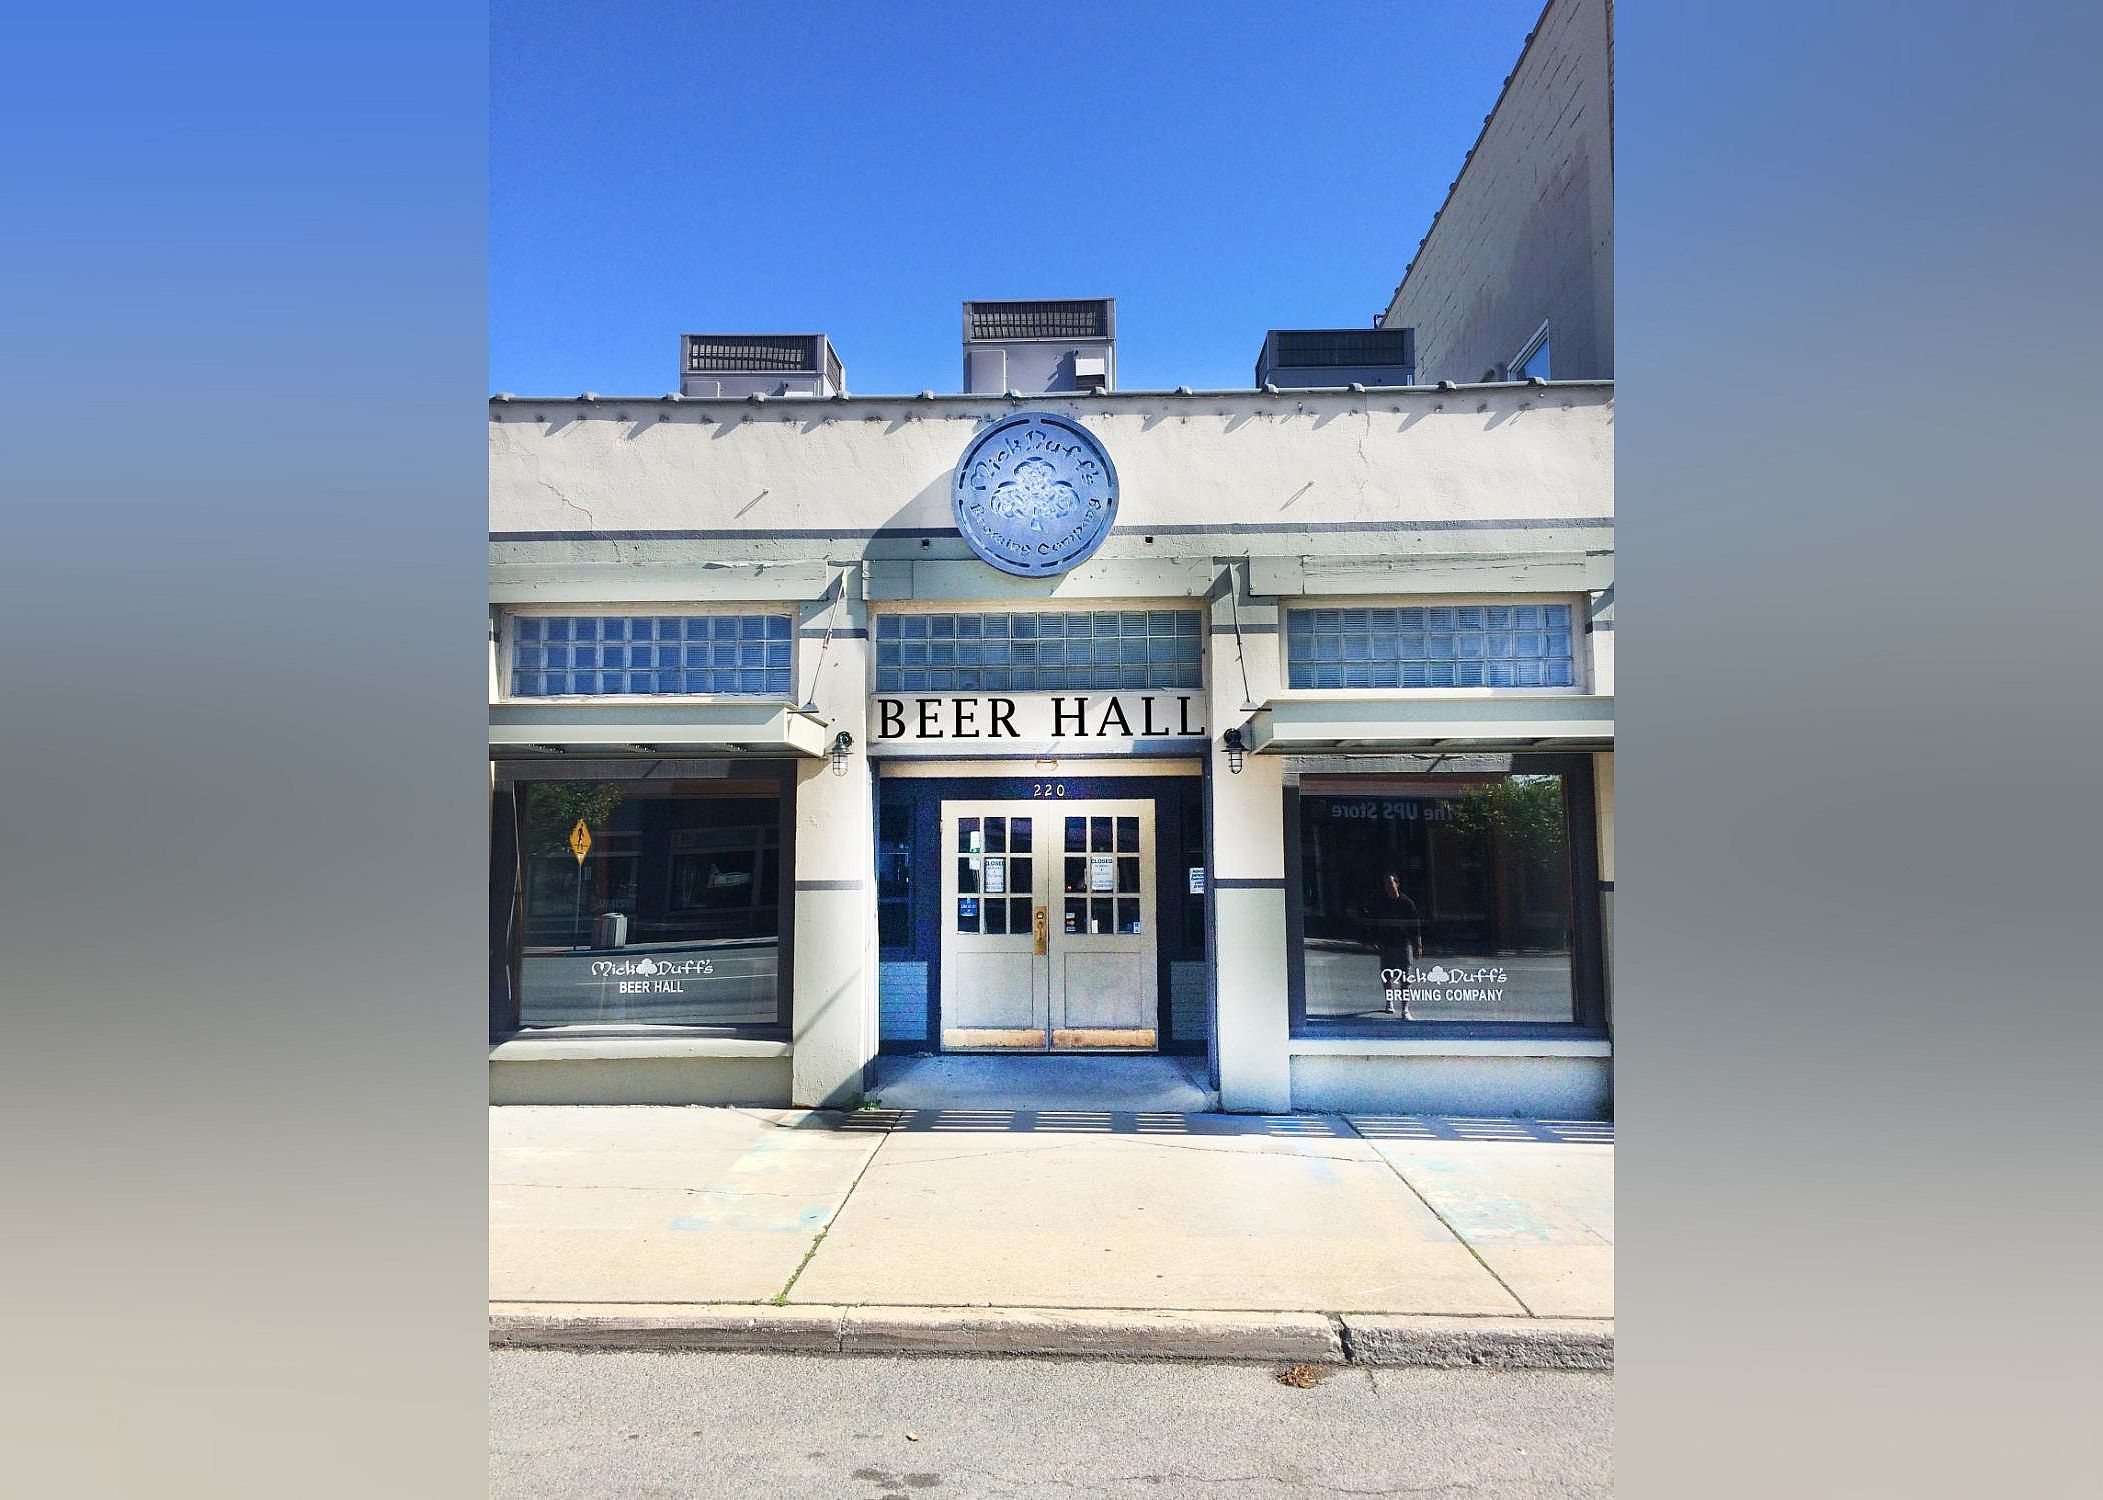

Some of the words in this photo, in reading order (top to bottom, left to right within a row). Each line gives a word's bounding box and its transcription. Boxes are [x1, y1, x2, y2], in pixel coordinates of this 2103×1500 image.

[970, 438, 1021, 491] Mick
[1037, 497, 1102, 555] Company
[877, 698, 1021, 739] BEER
[1050, 696, 1206, 738] HALL
[1033, 784, 1065, 797] 220
[591, 960, 636, 977] Mick
[656, 959, 714, 976] Duff's
[1381, 968, 1427, 984] Mick
[1448, 967, 1507, 984] Duff's
[619, 981, 651, 994] BEER
[654, 980, 684, 993] HALL
[1385, 989, 1441, 1001] BREWING
[1445, 988, 1504, 1001] COMPANY
